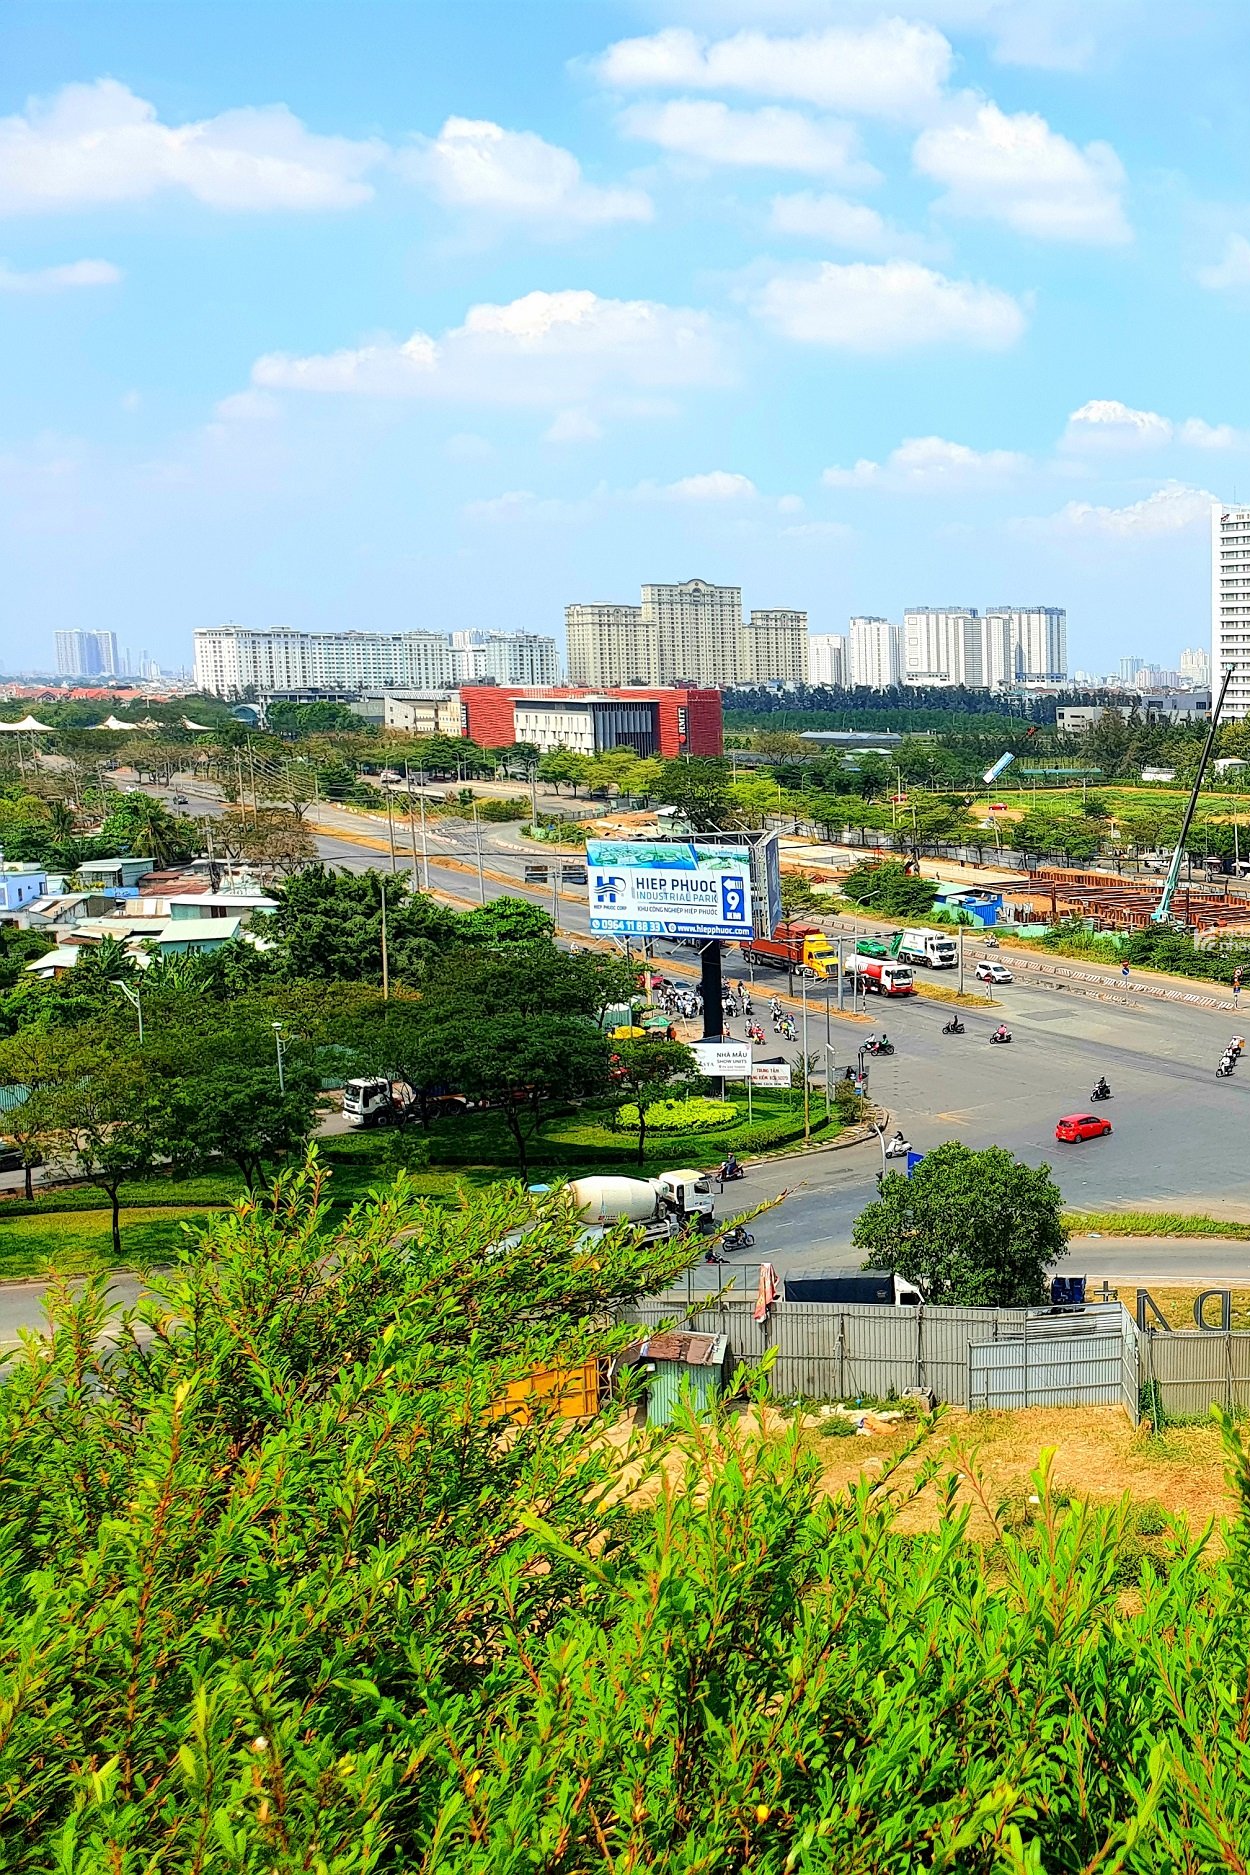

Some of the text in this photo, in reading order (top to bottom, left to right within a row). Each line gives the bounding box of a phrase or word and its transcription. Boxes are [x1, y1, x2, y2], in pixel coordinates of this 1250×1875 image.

[678, 707, 686, 734] RMIT
[636, 877, 717, 893] HIEP PHUOC
[636, 891, 718, 903] INDUSTRIAL PARK
[727, 891, 740, 911] 9
[649, 905, 664, 913] CÔNG
[727, 912, 741, 920] KM
[601, 919, 661, 932] 0964 11 88 33
[677, 924, 750, 936] www.hiepphuoc.com
